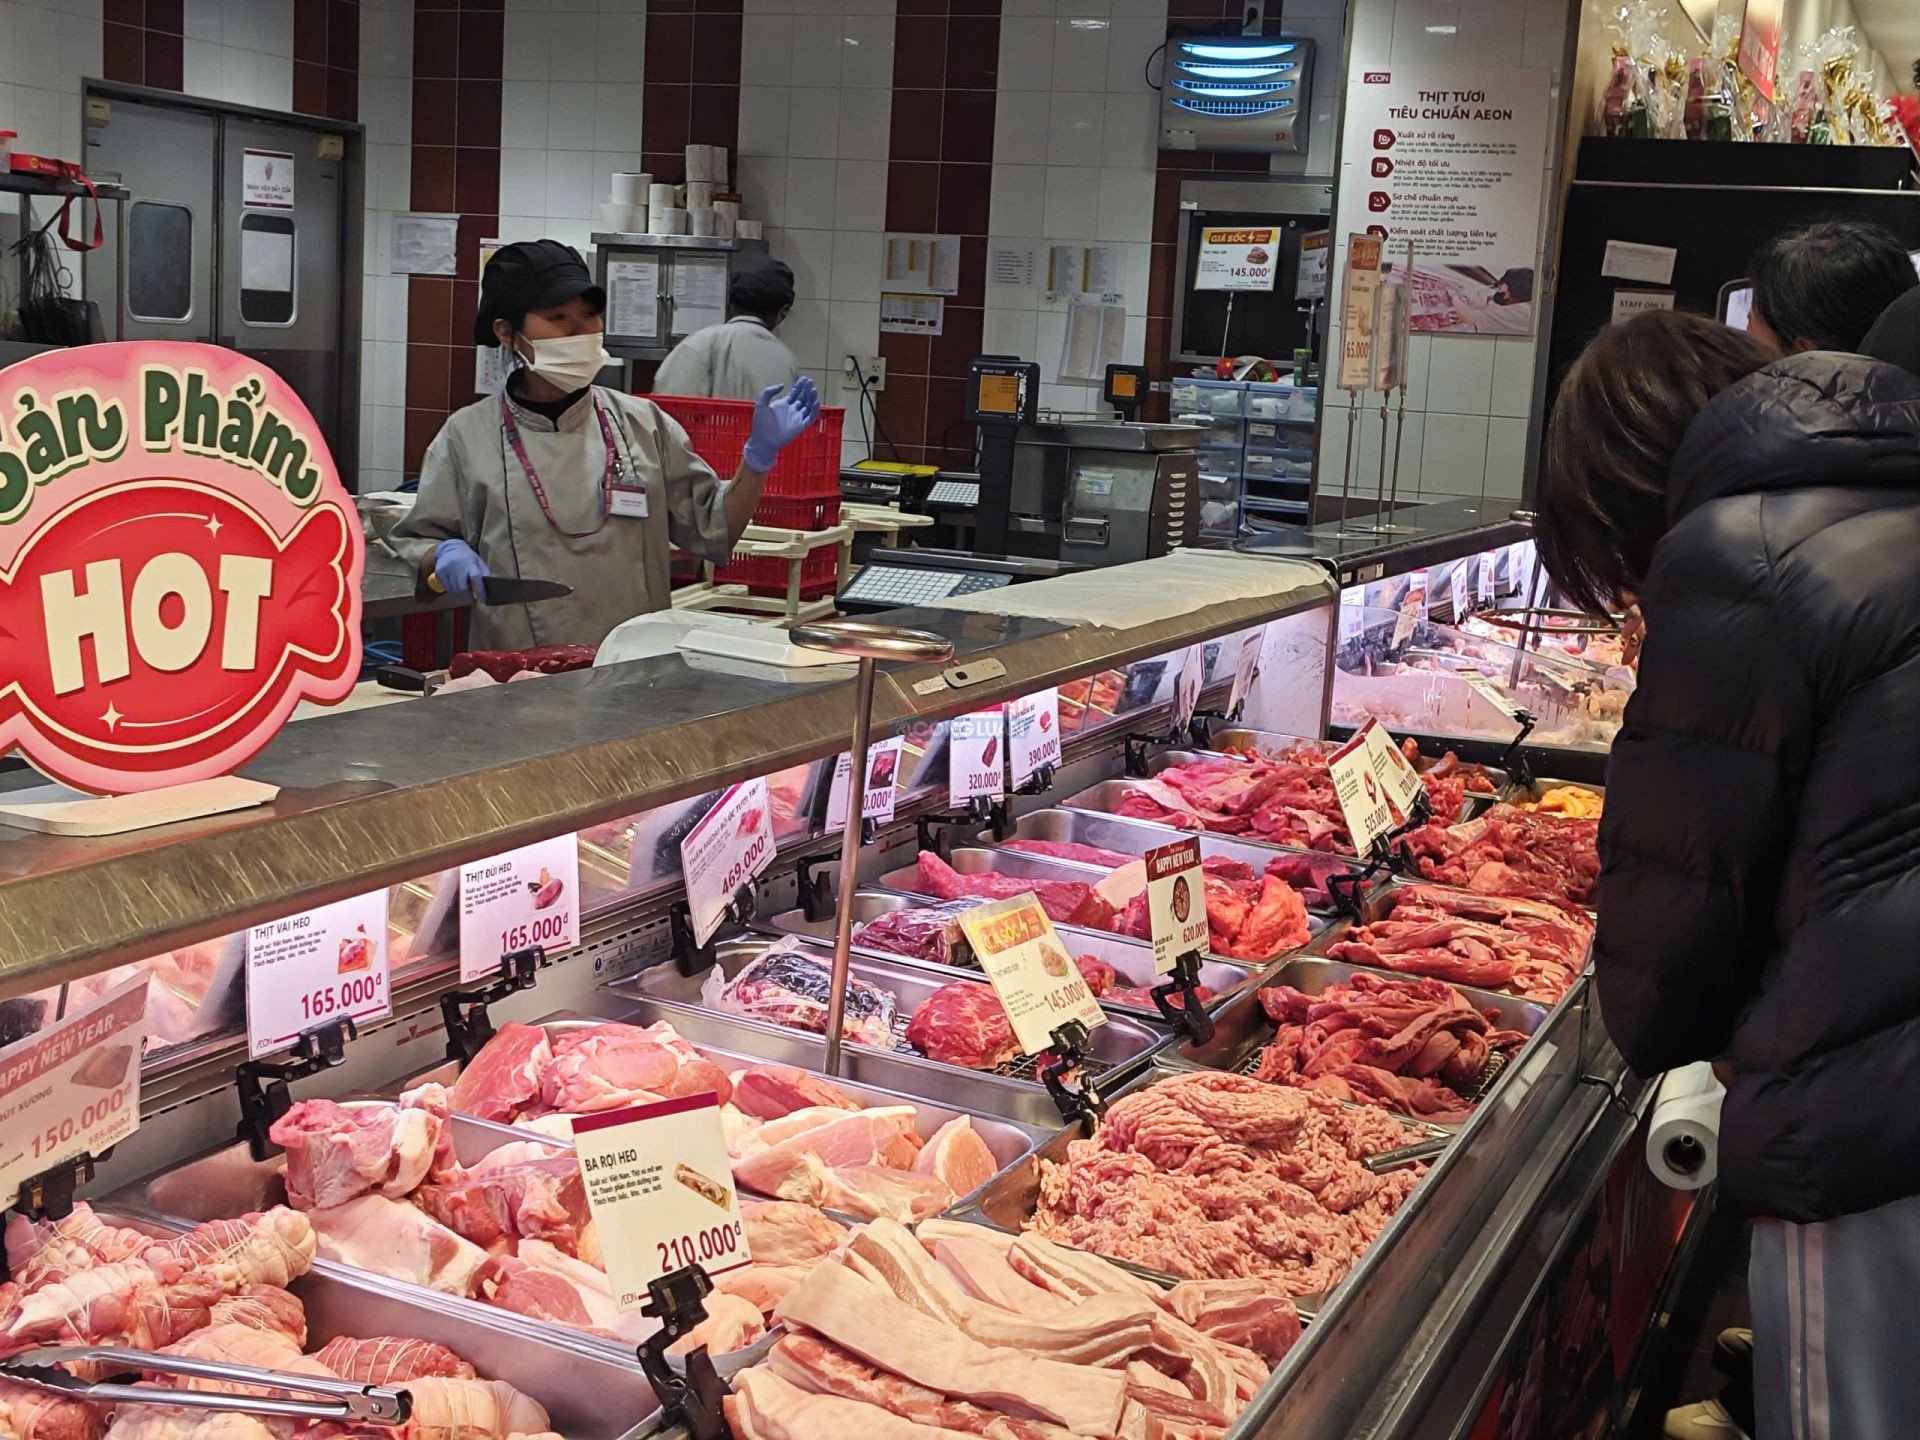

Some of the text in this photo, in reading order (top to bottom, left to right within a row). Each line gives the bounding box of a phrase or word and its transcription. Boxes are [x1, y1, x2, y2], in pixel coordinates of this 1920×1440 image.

[1389, 105, 1418, 119] TIÊU
[1473, 109, 1513, 121] AEON
[1418, 90, 1485, 105] THỊT TƯƠI
[143, 377, 319, 500] Phẩm
[39, 551, 274, 696] HOT
[465, 870, 484, 883] THỊT
[499, 861, 512, 874] HEO
[255, 916, 311, 940] THỊT VAI HEO
[501, 912, 569, 953] 165.000đ
[301, 972, 382, 1020] 165.000đ
[0, 1013, 115, 1090] APPY NEW YEAR
[31, 1082, 132, 1160] 150.000đ
[585, 1149, 637, 1172] BA RỌI HEO
[657, 1220, 742, 1274] 210.000đ
